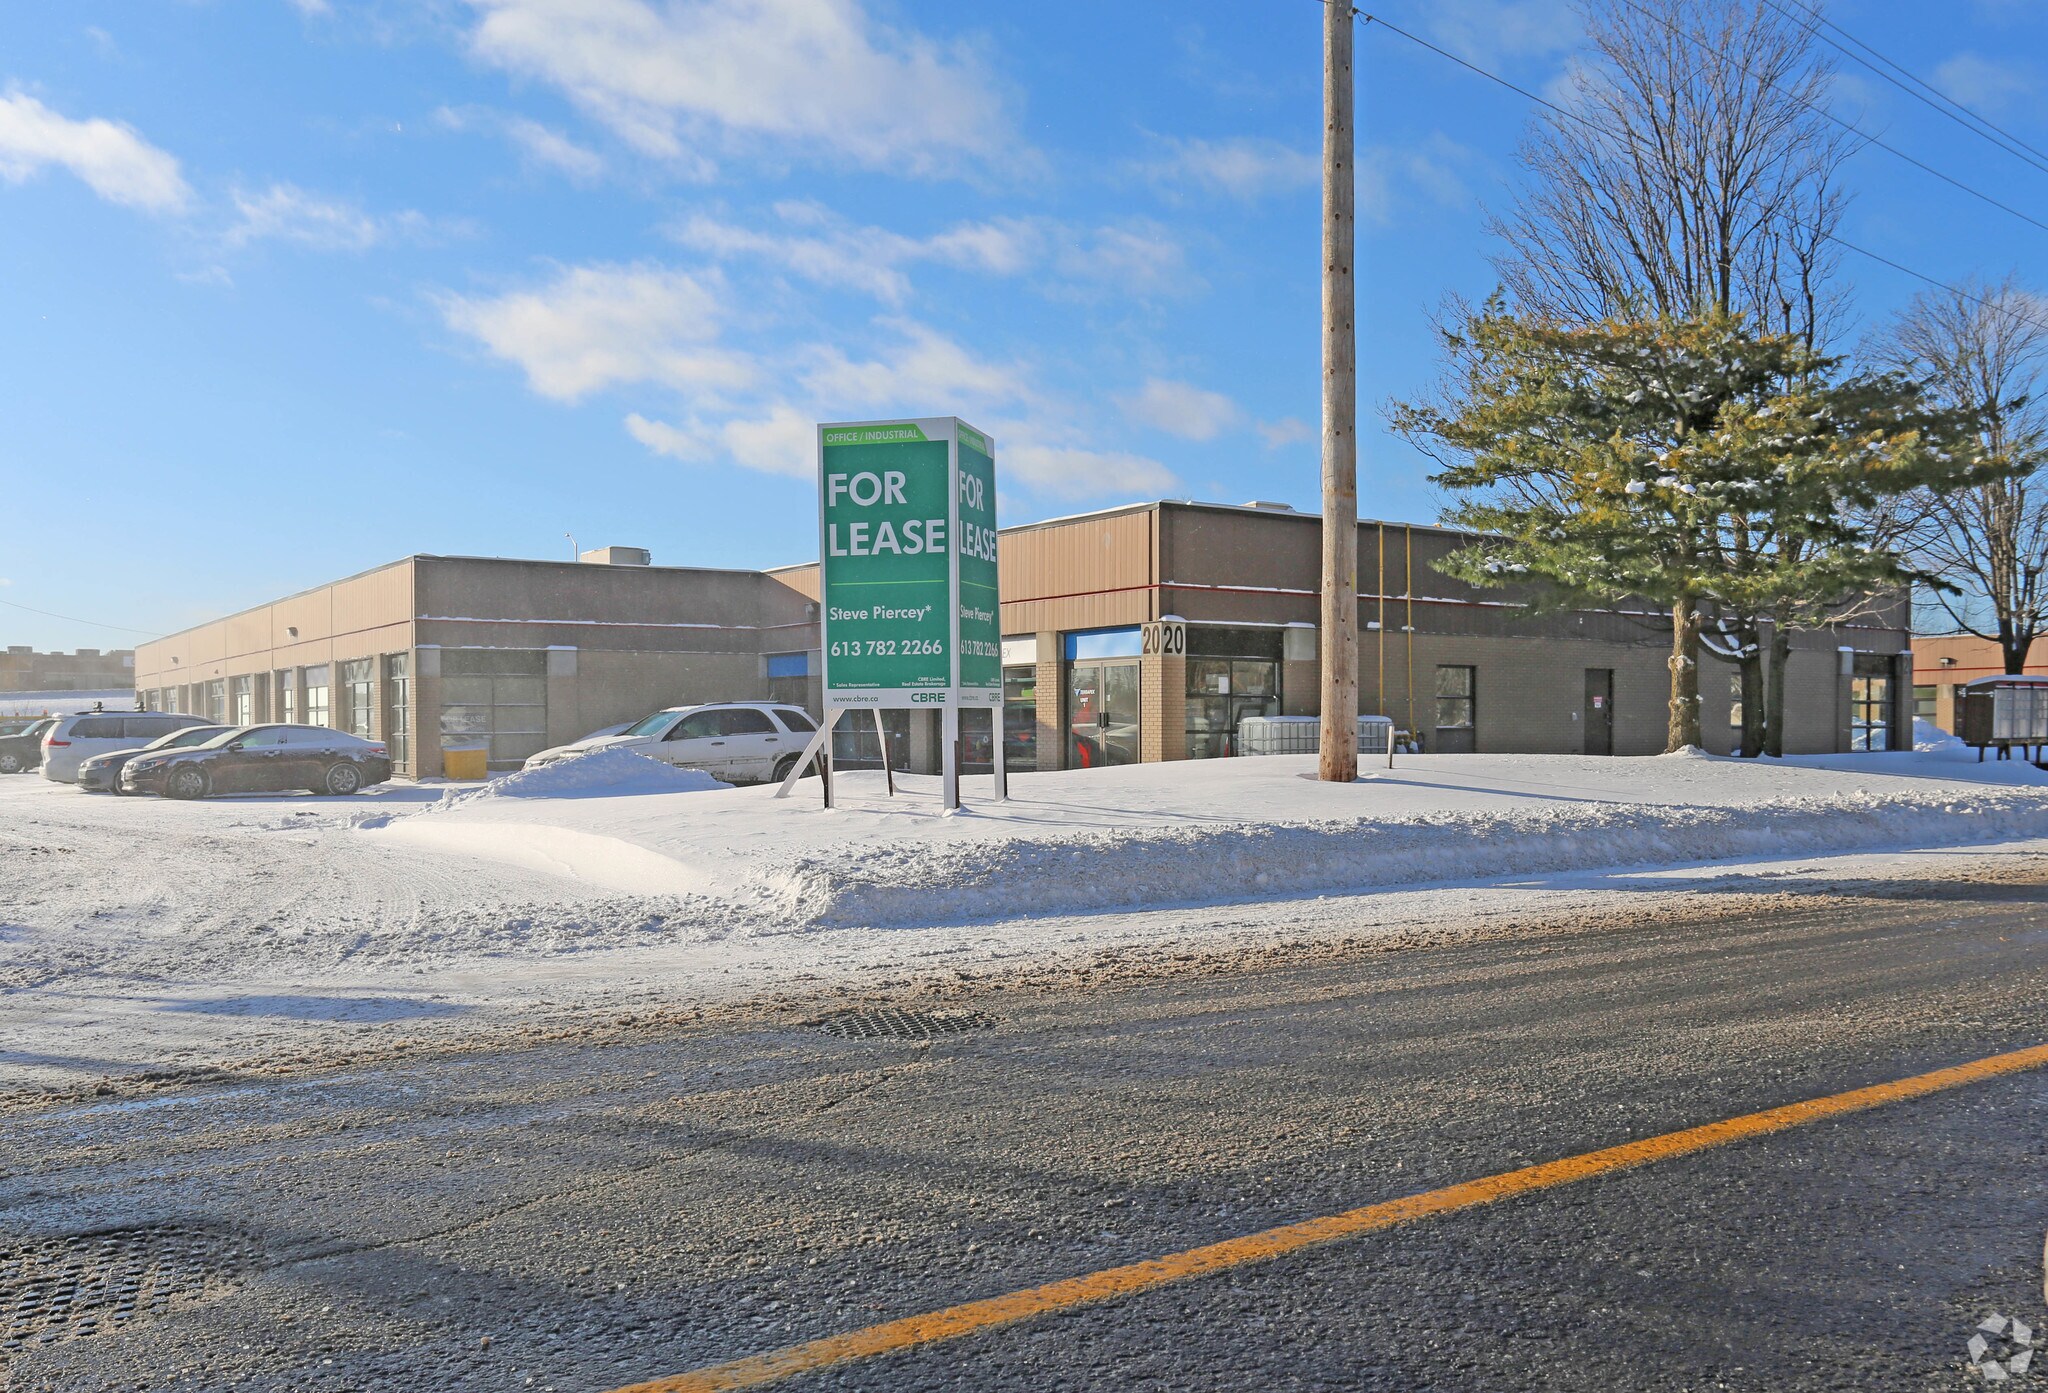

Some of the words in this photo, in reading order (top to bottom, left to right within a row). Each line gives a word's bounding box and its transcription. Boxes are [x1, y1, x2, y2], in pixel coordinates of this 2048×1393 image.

[826, 432, 858, 443] OFFICE
[859, 431, 864, 441] /
[865, 429, 919, 441] INDUSTRIAL
[828, 470, 908, 507] FOR
[959, 469, 984, 512] FOR
[829, 519, 945, 557] LEASE
[959, 520, 997, 563] LEASE
[829, 606, 868, 621] Steve
[960, 604, 974, 619] Steve
[831, 641, 861, 657] 613
[866, 640, 896, 656] 782
[901, 639, 943, 656] 2266
[960, 640, 972, 655] 613
[972, 641, 984, 656] 782
[984, 642, 999, 657] 2266
[833, 695, 879, 703] www.cbre.ca
[911, 692, 946, 703] CBRE
